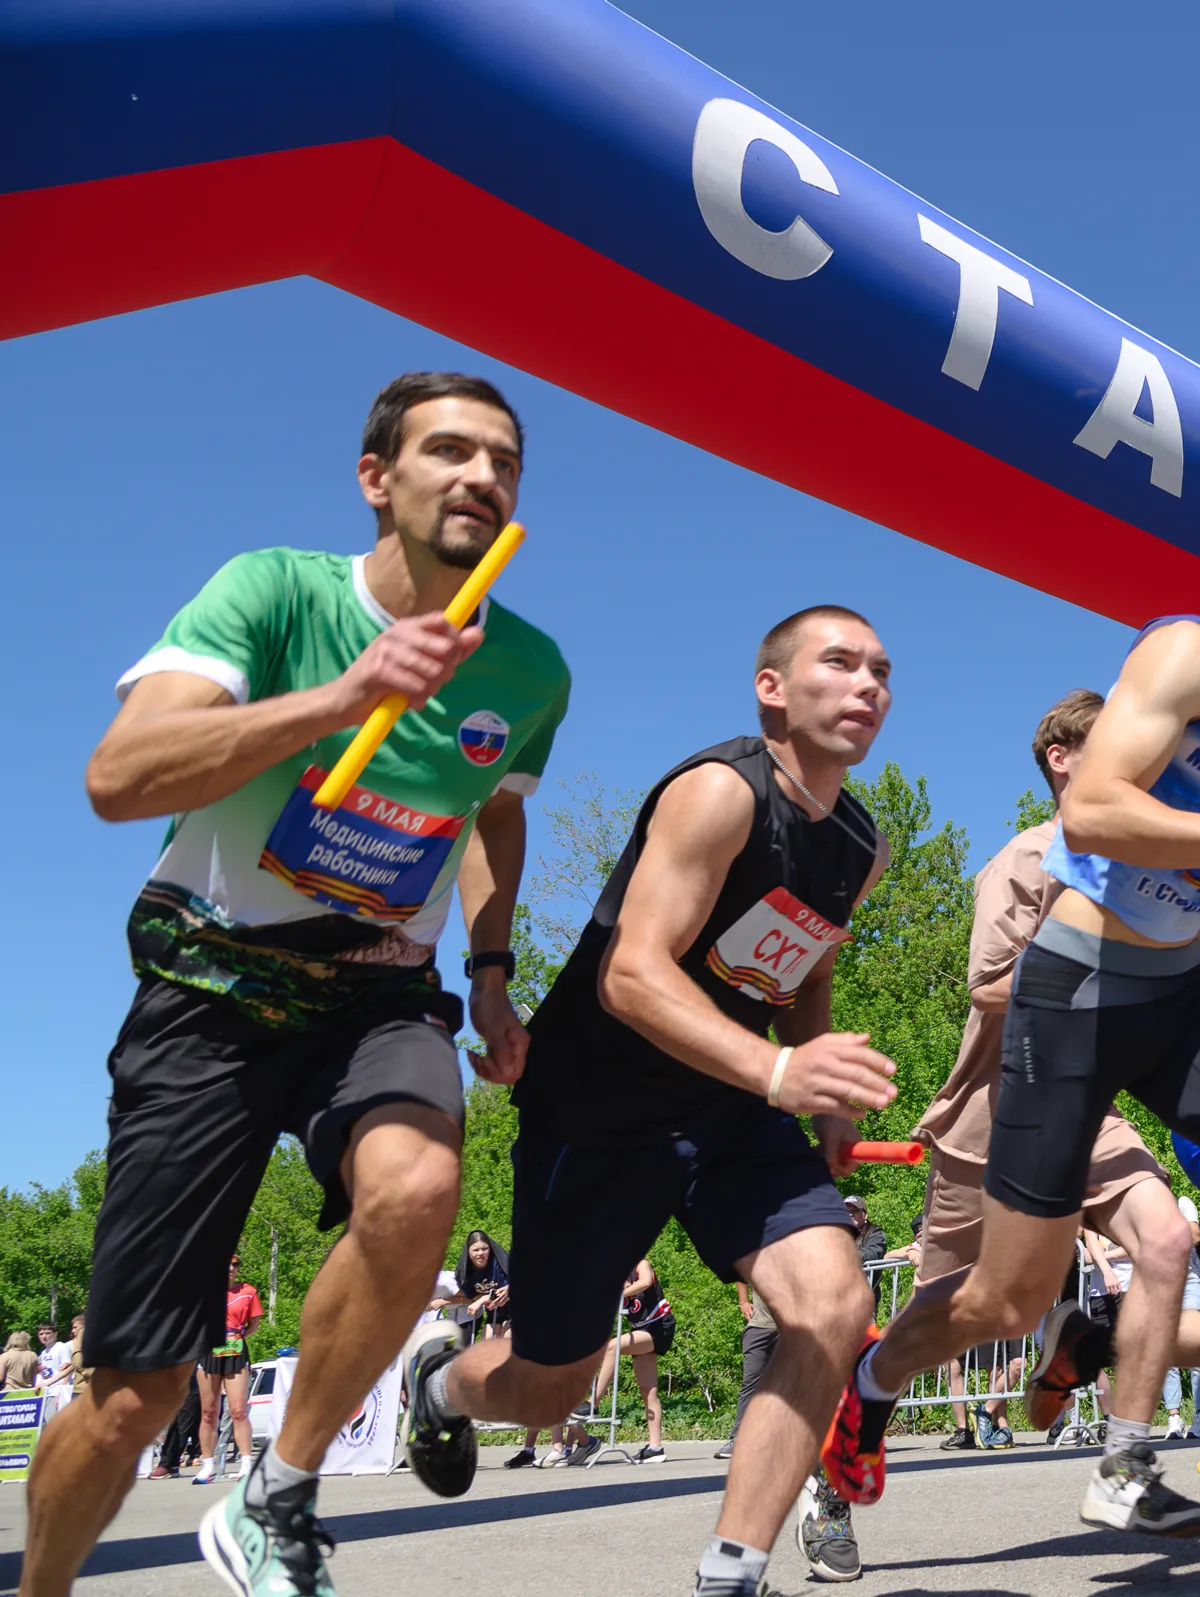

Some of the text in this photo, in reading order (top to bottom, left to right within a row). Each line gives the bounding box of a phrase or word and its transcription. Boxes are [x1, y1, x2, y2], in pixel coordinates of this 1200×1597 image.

[356, 793, 428, 833] 9 МАЯ
[309, 808, 425, 864] Медицинские
[306, 843, 401, 886] работники
[795, 909, 809, 921] 9
